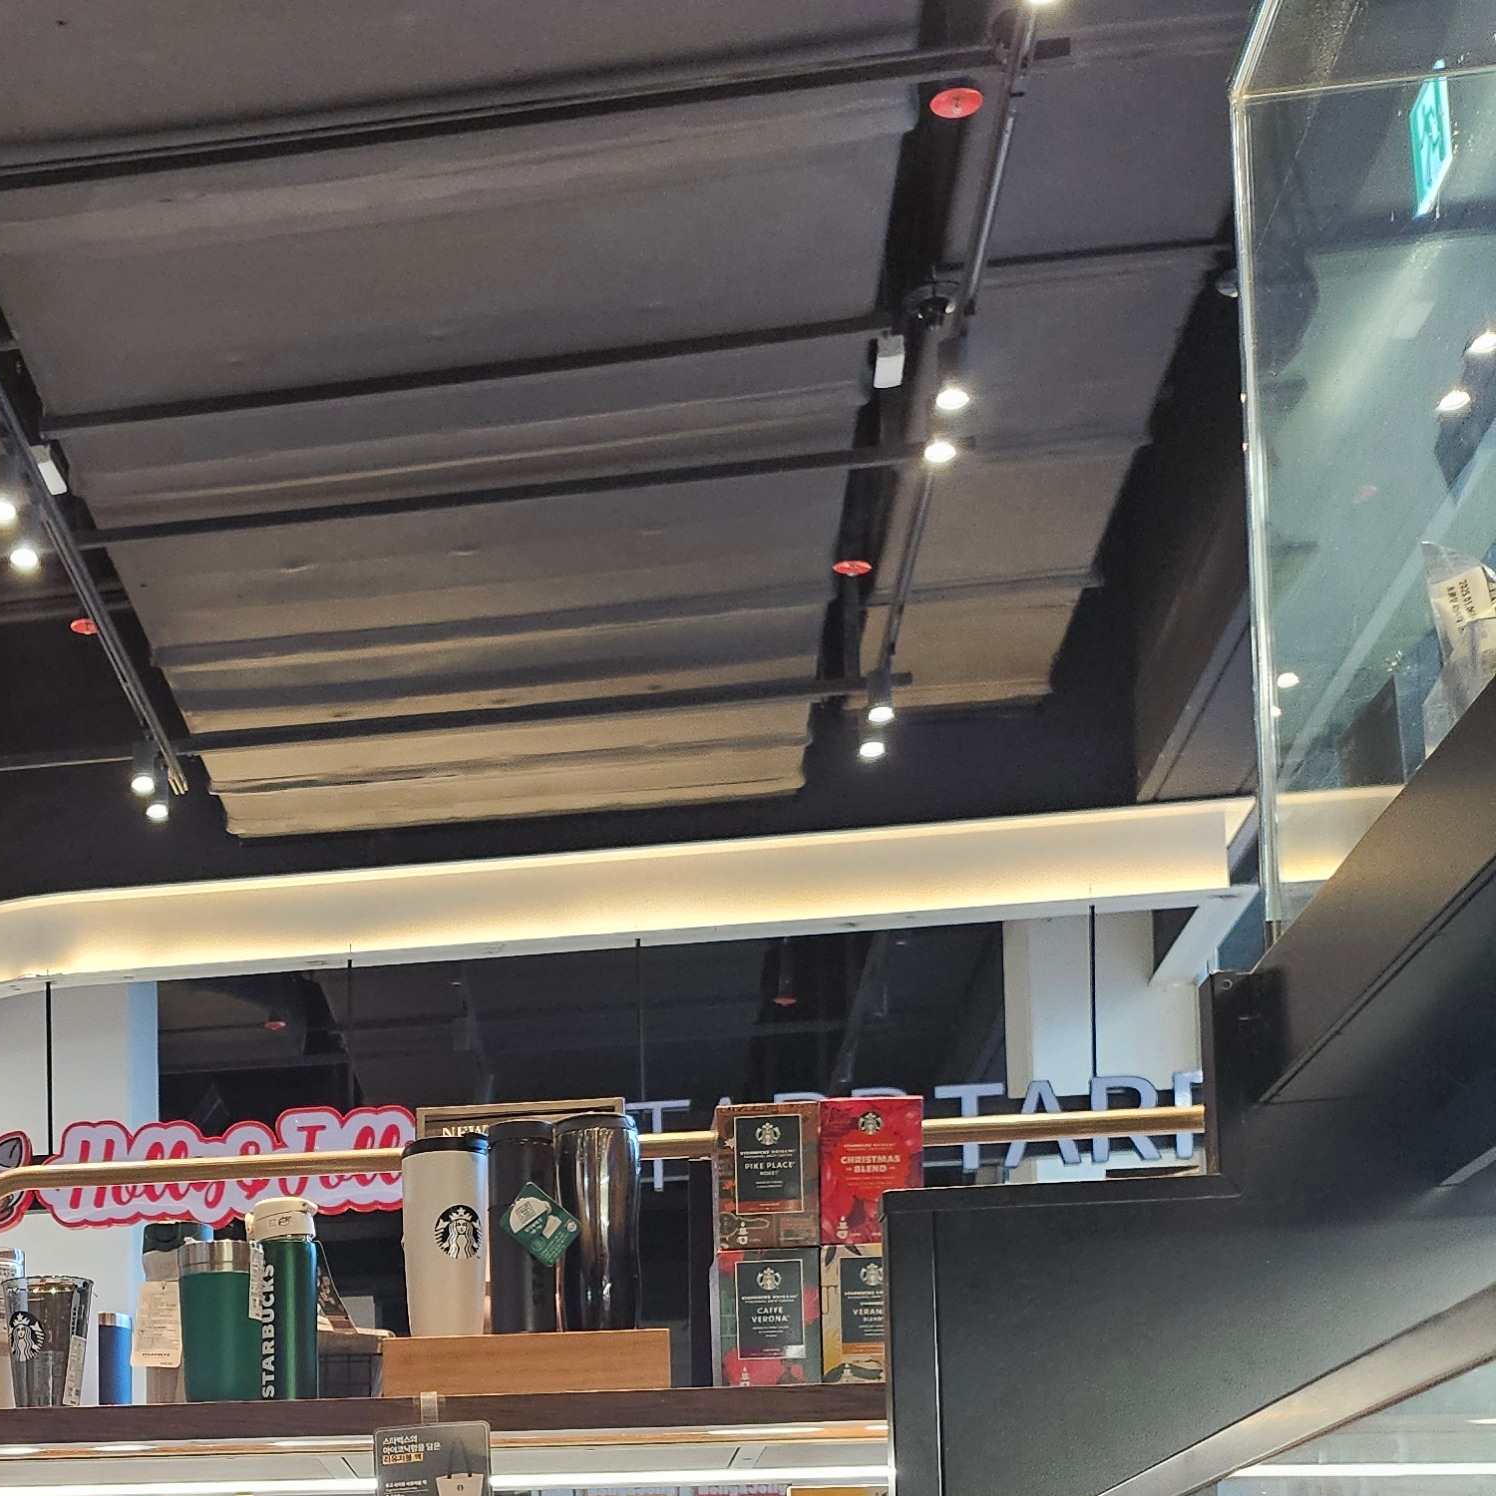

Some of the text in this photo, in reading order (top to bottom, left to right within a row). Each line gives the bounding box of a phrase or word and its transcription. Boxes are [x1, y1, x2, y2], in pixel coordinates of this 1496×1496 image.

[840, 1154, 901, 1164] CHRISTMAS
[744, 1162, 765, 1170] PIKE
[853, 1165, 888, 1174] BLEND
[751, 1314, 790, 1323] VERONA
[261, 1263, 275, 1398] STARBUCKS
